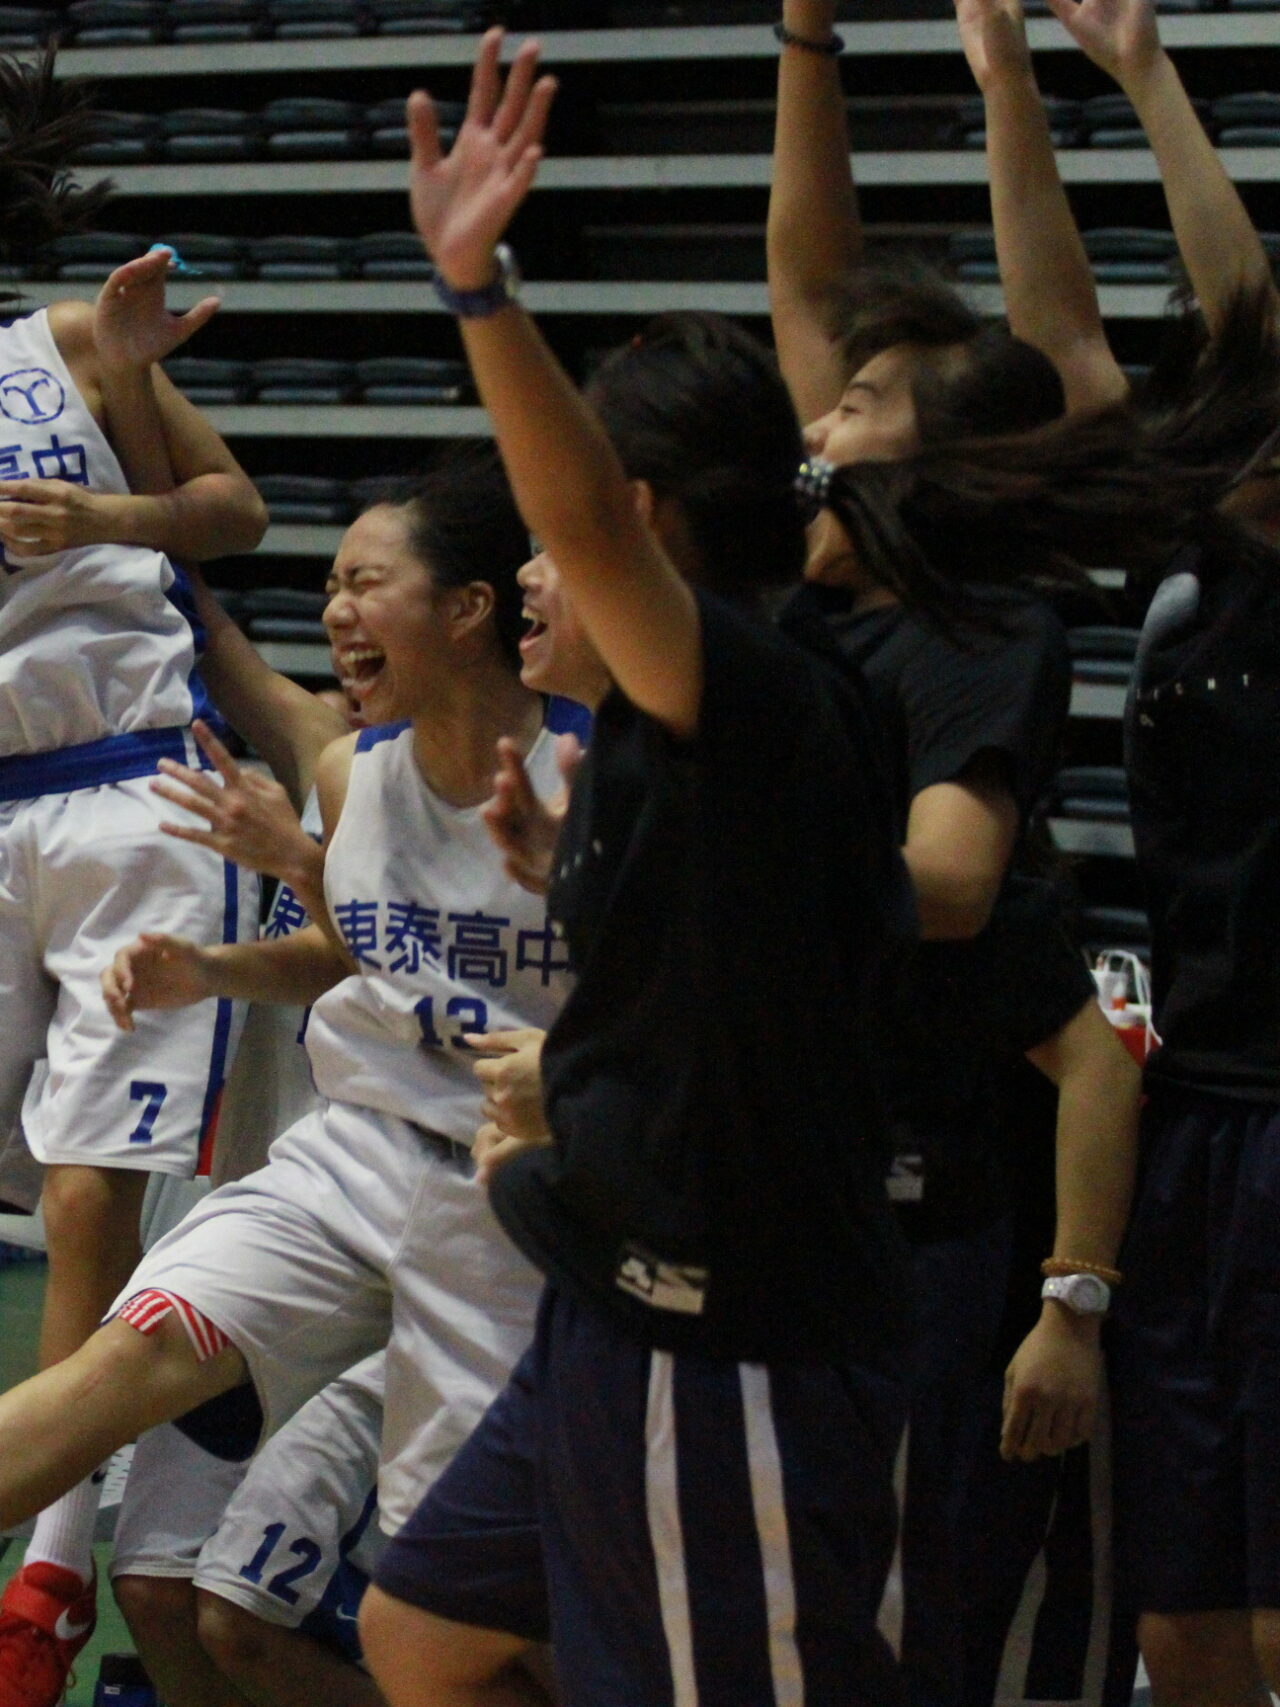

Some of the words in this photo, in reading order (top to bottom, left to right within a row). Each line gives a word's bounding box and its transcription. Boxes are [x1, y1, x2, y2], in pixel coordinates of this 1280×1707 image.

[334, 899, 571, 988] 東泰高中
[414, 996, 489, 1049] 13
[129, 1080, 168, 1144] 7
[239, 1522, 322, 1606] 12
